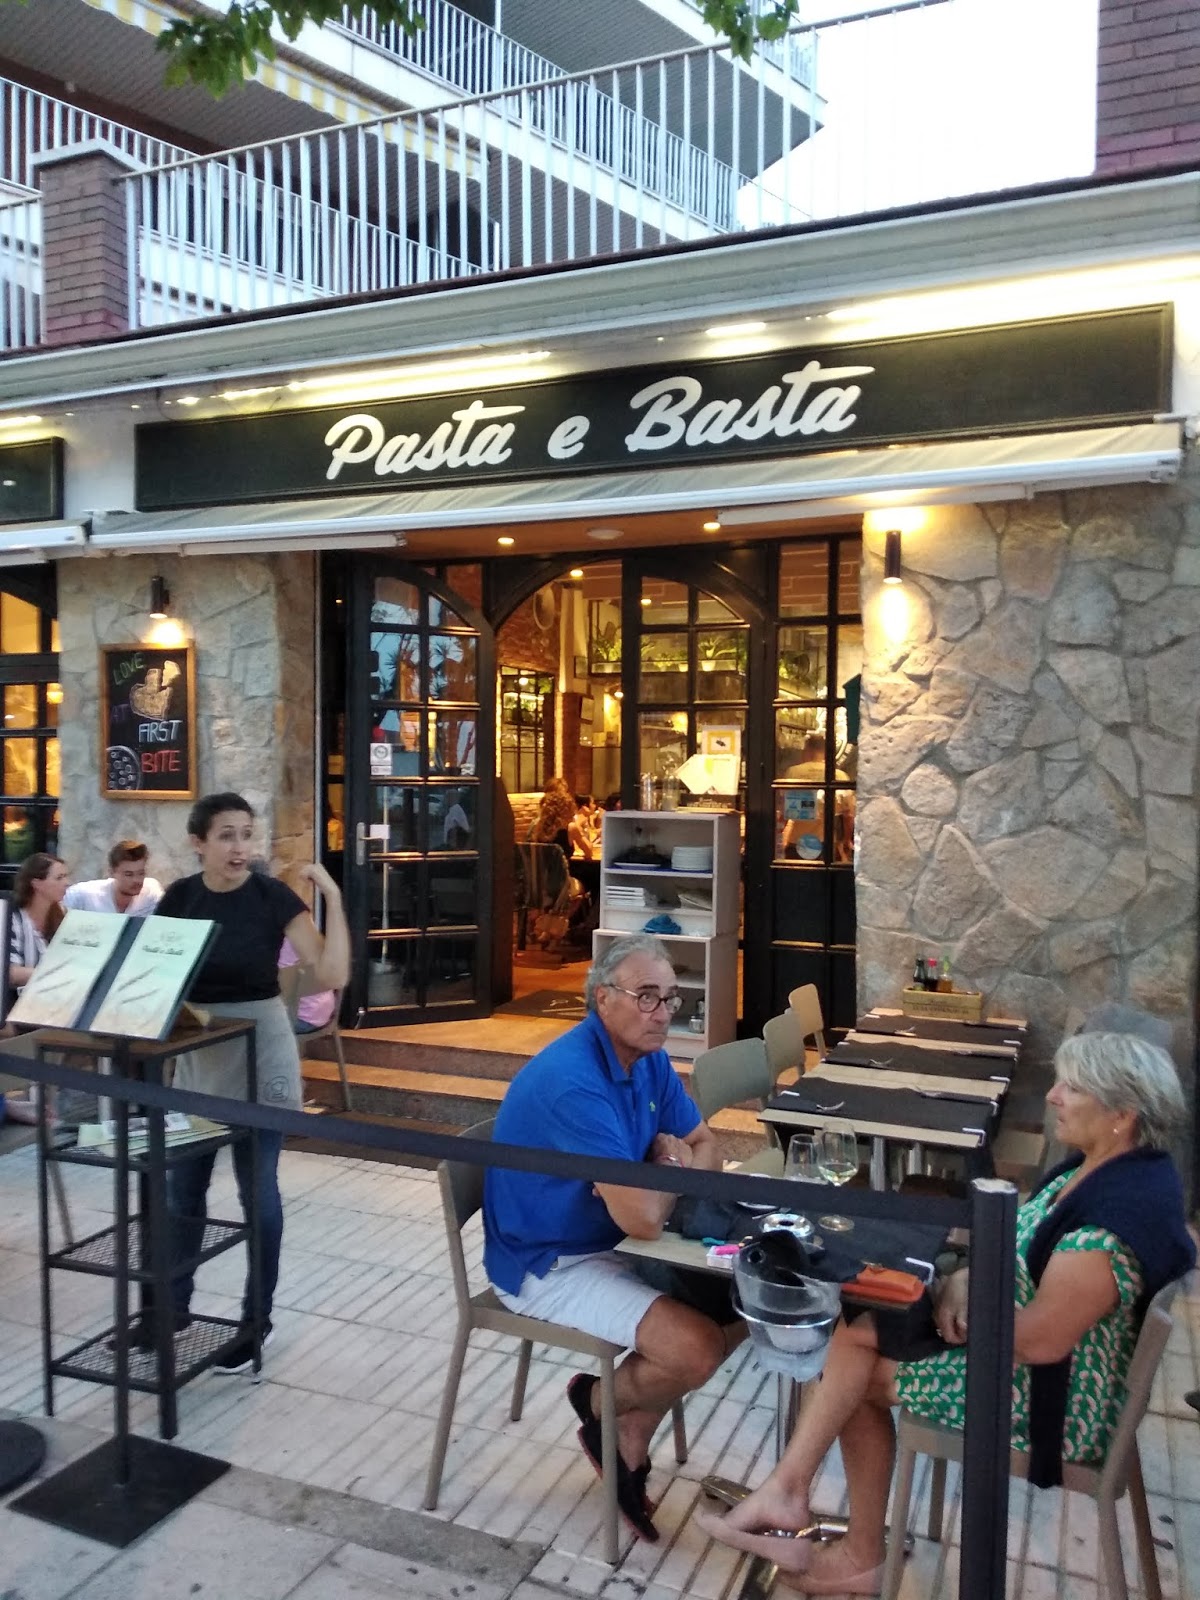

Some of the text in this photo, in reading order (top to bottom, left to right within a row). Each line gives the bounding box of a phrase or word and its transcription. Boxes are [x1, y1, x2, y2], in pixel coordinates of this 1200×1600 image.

[324, 360, 875, 480] Pasta e Basta
[113, 653, 146, 685] LOVE
[138, 719, 182, 743] FIRST
[141, 750, 181, 773] BITE
